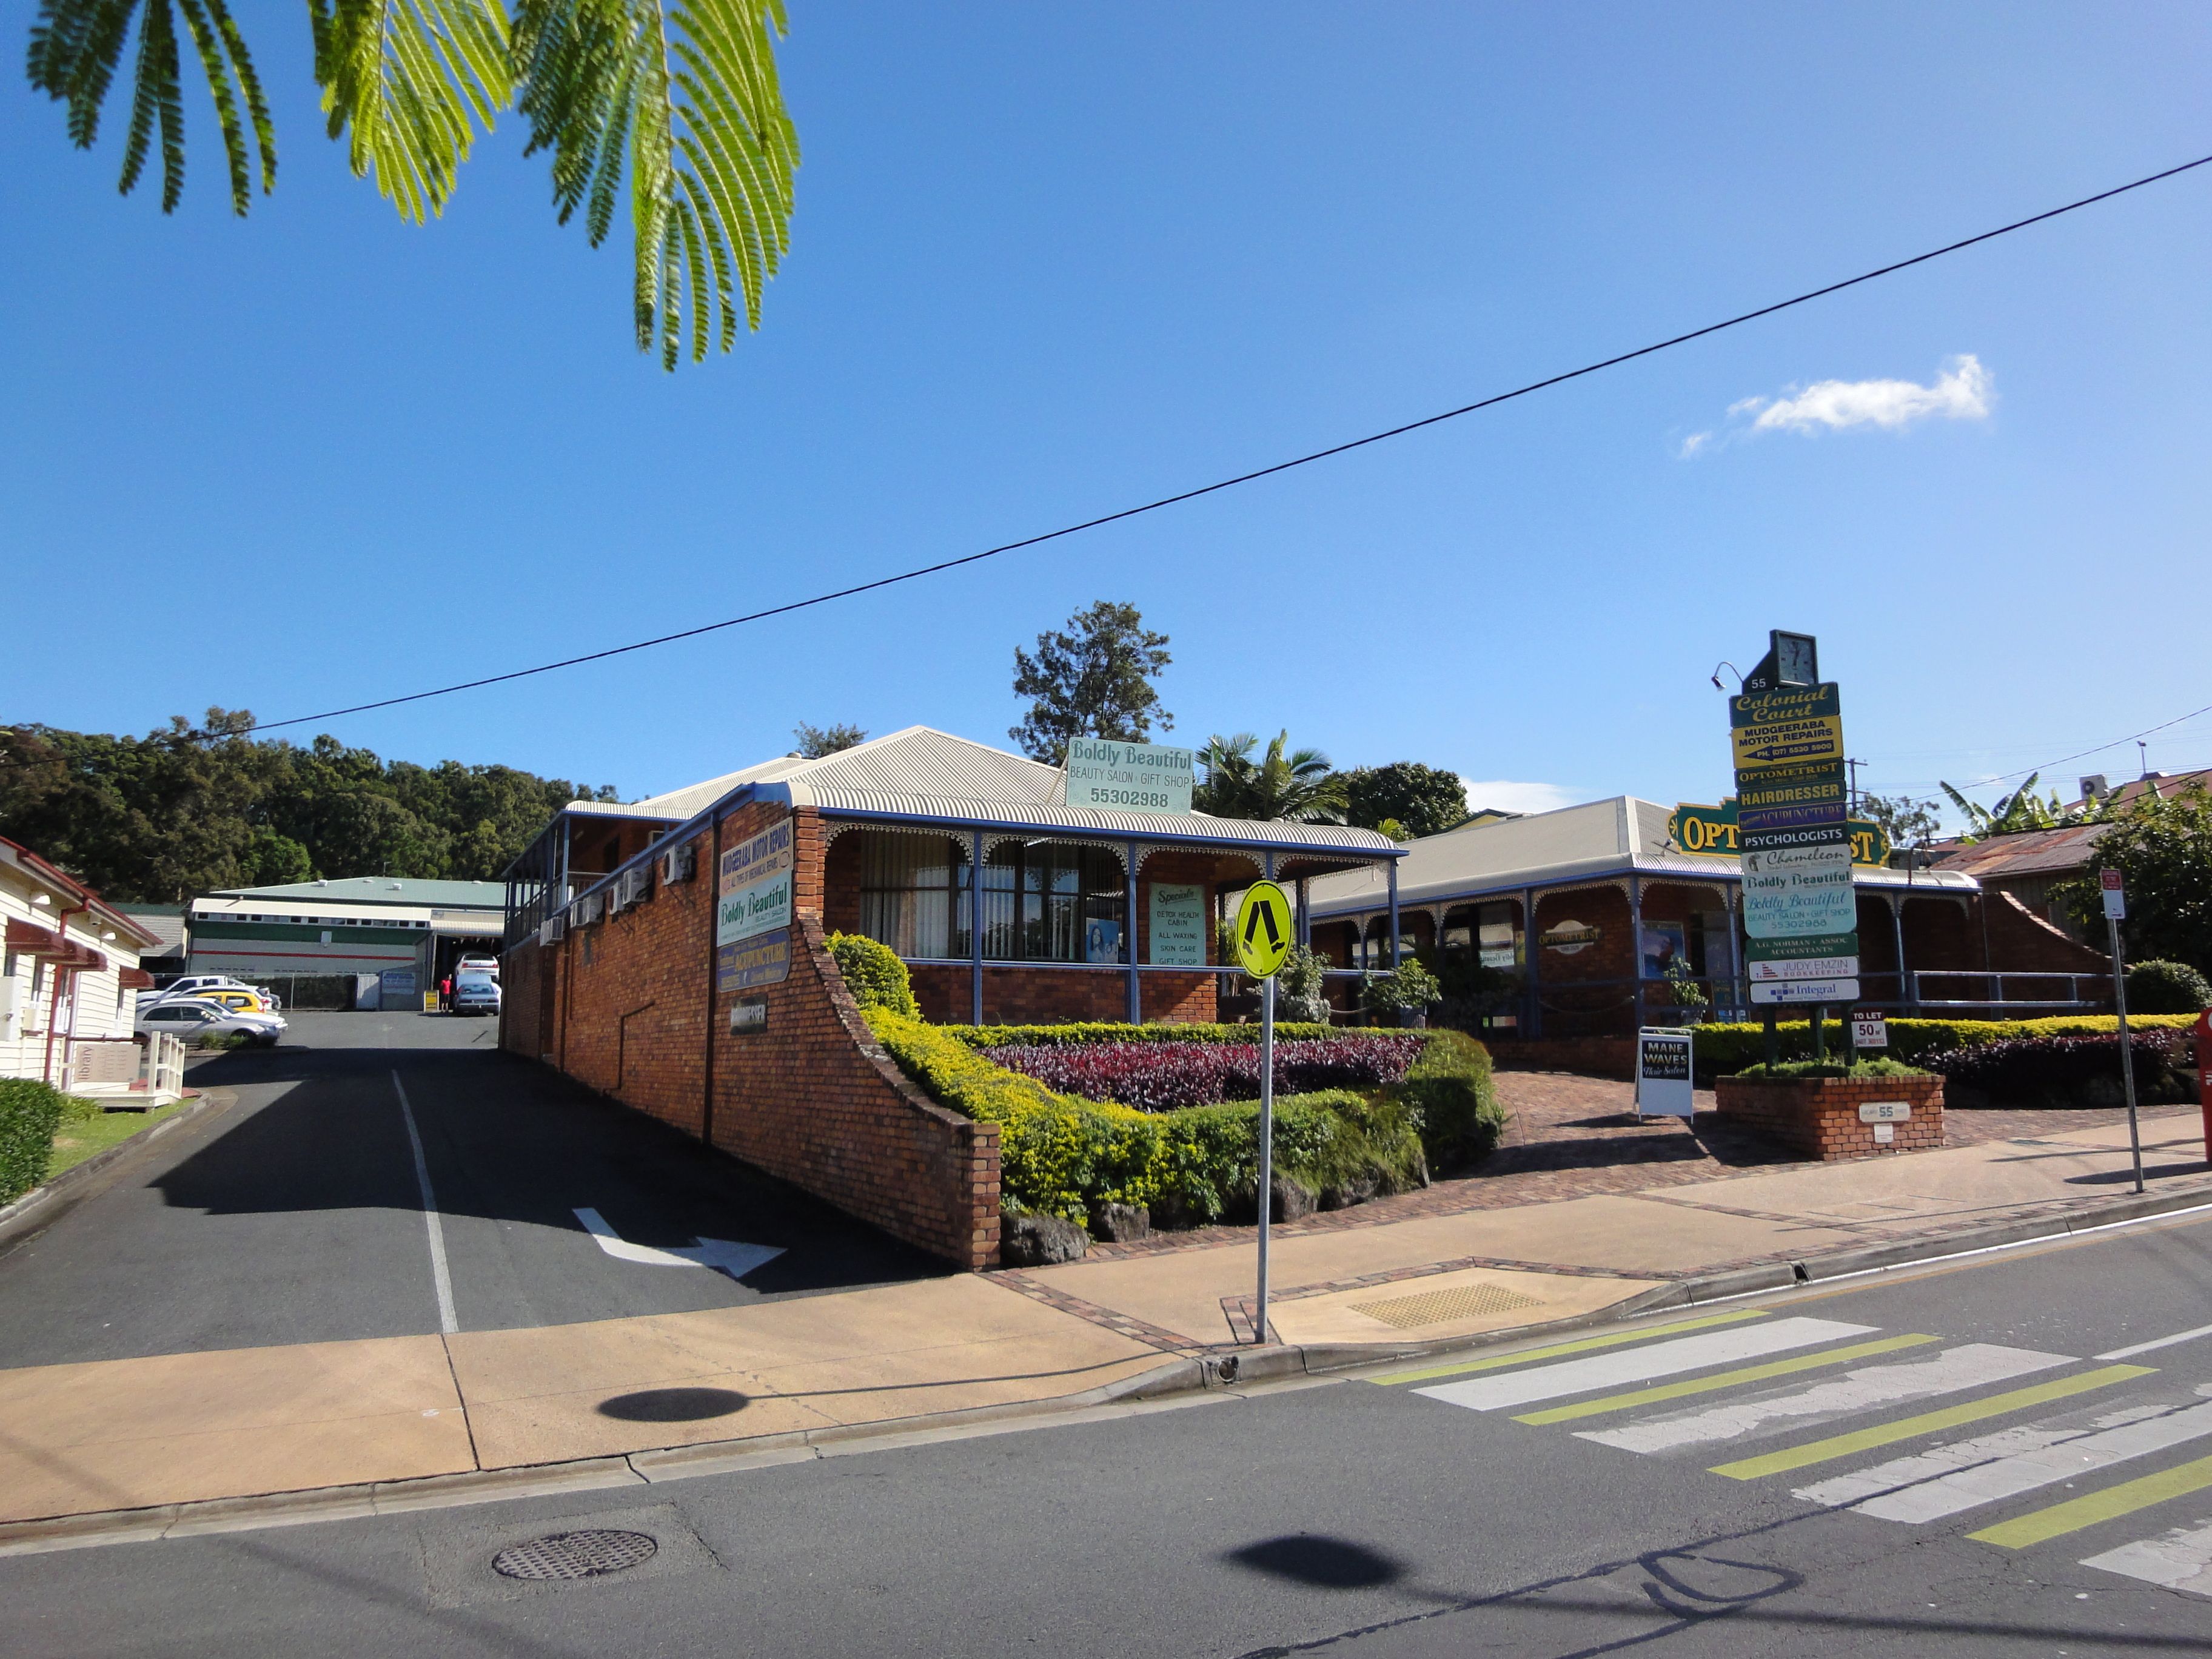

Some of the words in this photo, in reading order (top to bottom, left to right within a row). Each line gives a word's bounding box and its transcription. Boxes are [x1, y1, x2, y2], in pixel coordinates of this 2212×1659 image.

[1751, 679, 1766, 689] 55
[1736, 685, 1829, 711] Colonial
[1752, 703, 1813, 722] Court
[1738, 735, 1779, 747] MOTOR
[1783, 728, 1834, 742] REPAIRS
[1744, 720, 1826, 737] MUDGEERABA
[1071, 740, 1121, 767] Boldly
[1124, 745, 1192, 770] Beautiful
[1772, 748, 1786, 756] (07)
[1070, 766, 1105, 780] BEAUTY
[1107, 770, 1133, 783] SALON
[1141, 773, 1161, 786] GIFT
[1164, 775, 1190, 788] SHOP
[1739, 762, 1838, 782] OPTOMETRIST
[1090, 787, 1169, 808] 55302988
[1741, 783, 1840, 806] HAIRDRESSER
[769, 823, 789, 854] REPAIRS
[1744, 829, 1843, 847] PSYCHOLOGISTS
[1766, 847, 1845, 865] Chameleon
[1746, 876, 1786, 889] Boldly
[1791, 871, 1850, 886] Beautiful
[722, 903, 745, 927] Boldly
[748, 882, 787, 917] Beautiful
[1746, 896, 1788, 912] Boldly
[1789, 891, 1847, 909] Beautiful
[1748, 912, 1777, 922] BEAUTY
[1779, 911, 1805, 920] SALON
[1810, 909, 1829, 917] GIFT
[1830, 908, 1851, 917] SHOP
[1771, 919, 1827, 929] 55302988
[1771, 947, 1834, 956] ACCOUNTANTS
[1783, 961, 1812, 971] JUDY
[1814, 959, 1849, 970] EMZIN
[1797, 983, 1837, 996] Integral
[1858, 1024, 1874, 1036] 50
[1647, 1042, 1683, 1053] MANE
[78, 1047, 93, 1080] library
[1644, 1053, 1687, 1065] WAVES
[1879, 1106, 1894, 1117] 55
